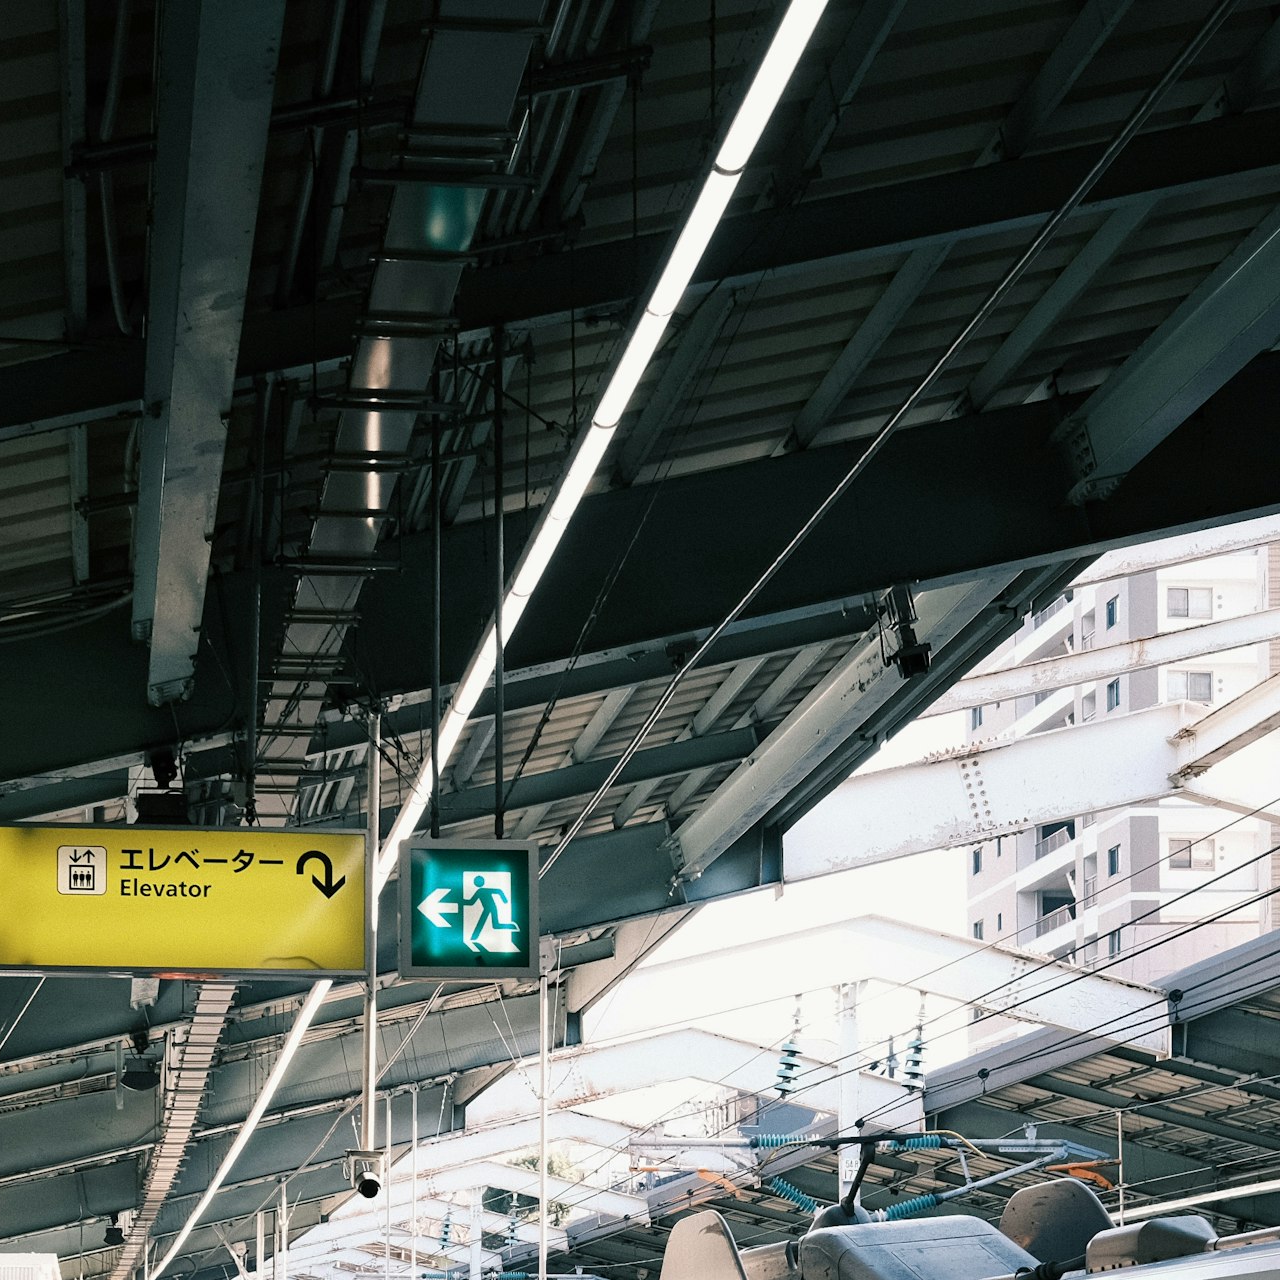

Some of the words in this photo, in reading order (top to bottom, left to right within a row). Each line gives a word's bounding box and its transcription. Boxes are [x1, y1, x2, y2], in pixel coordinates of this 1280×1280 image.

[119, 847, 284, 873] エレベーター
[120, 878, 212, 898] Elevator
